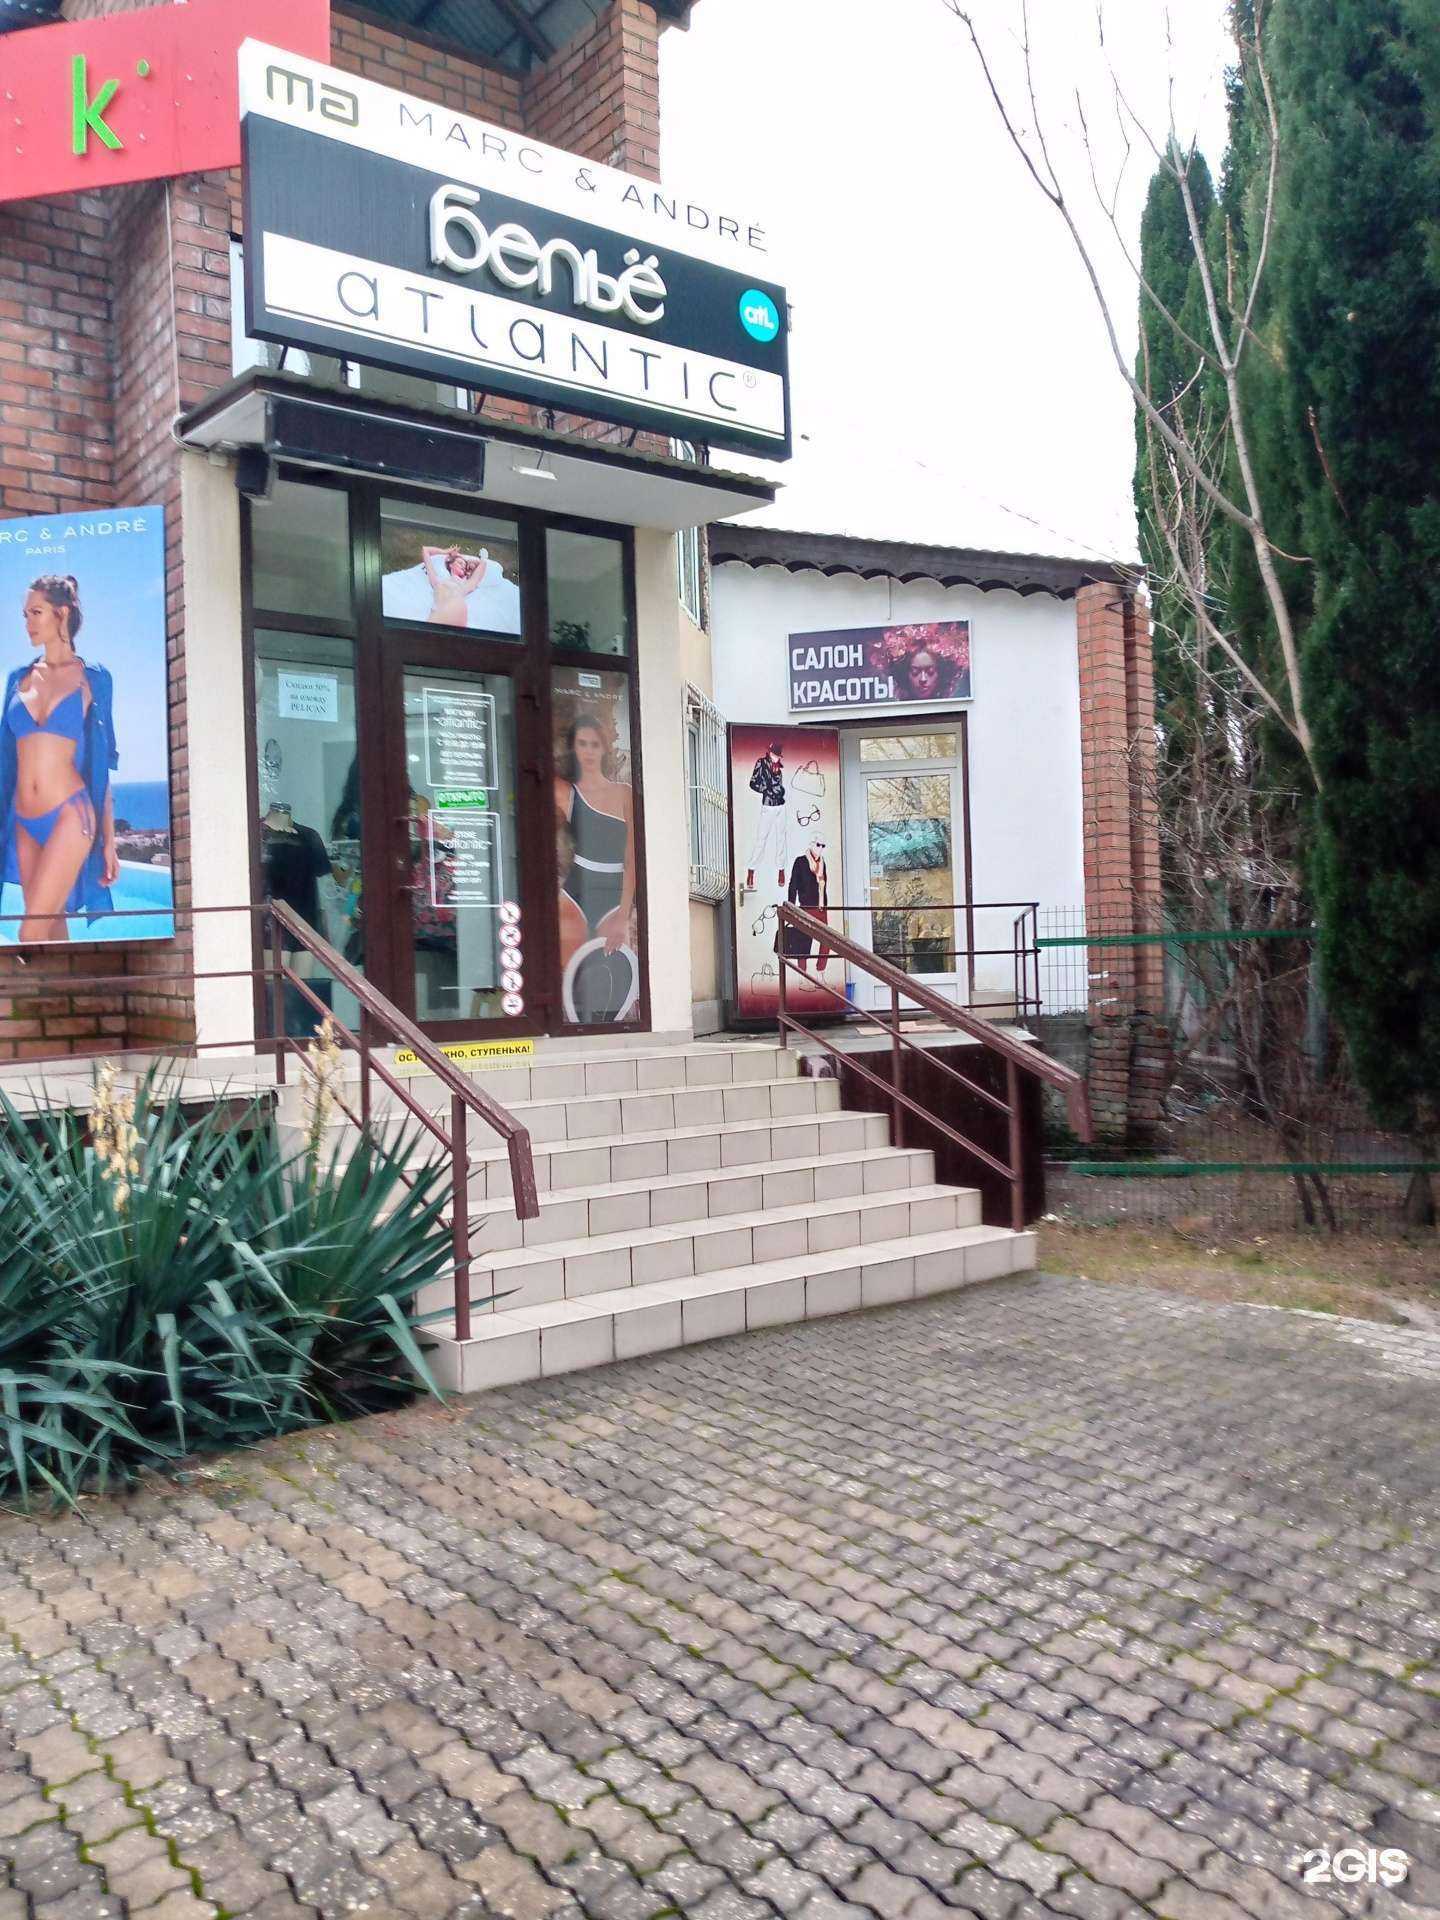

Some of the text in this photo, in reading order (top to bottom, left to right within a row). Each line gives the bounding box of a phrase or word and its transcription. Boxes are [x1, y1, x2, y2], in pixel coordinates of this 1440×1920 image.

[399, 103, 544, 173] MARC
[575, 167, 596, 192] &
[622, 184, 768, 252] ANDRÉ
[429, 184, 668, 325] бельё
[40, 527, 53, 540] &
[64, 516, 147, 539] ANDRÉ
[25, 544, 66, 556] PARIS
[792, 644, 863, 671] САЛОН
[793, 676, 894, 705] КРАСОТЫ
[290, 702, 328, 713] PELICAN
[439, 791, 485, 802] ОТКРЫТО
[470, 1045, 530, 1057] СТУПЕНЬКА!
